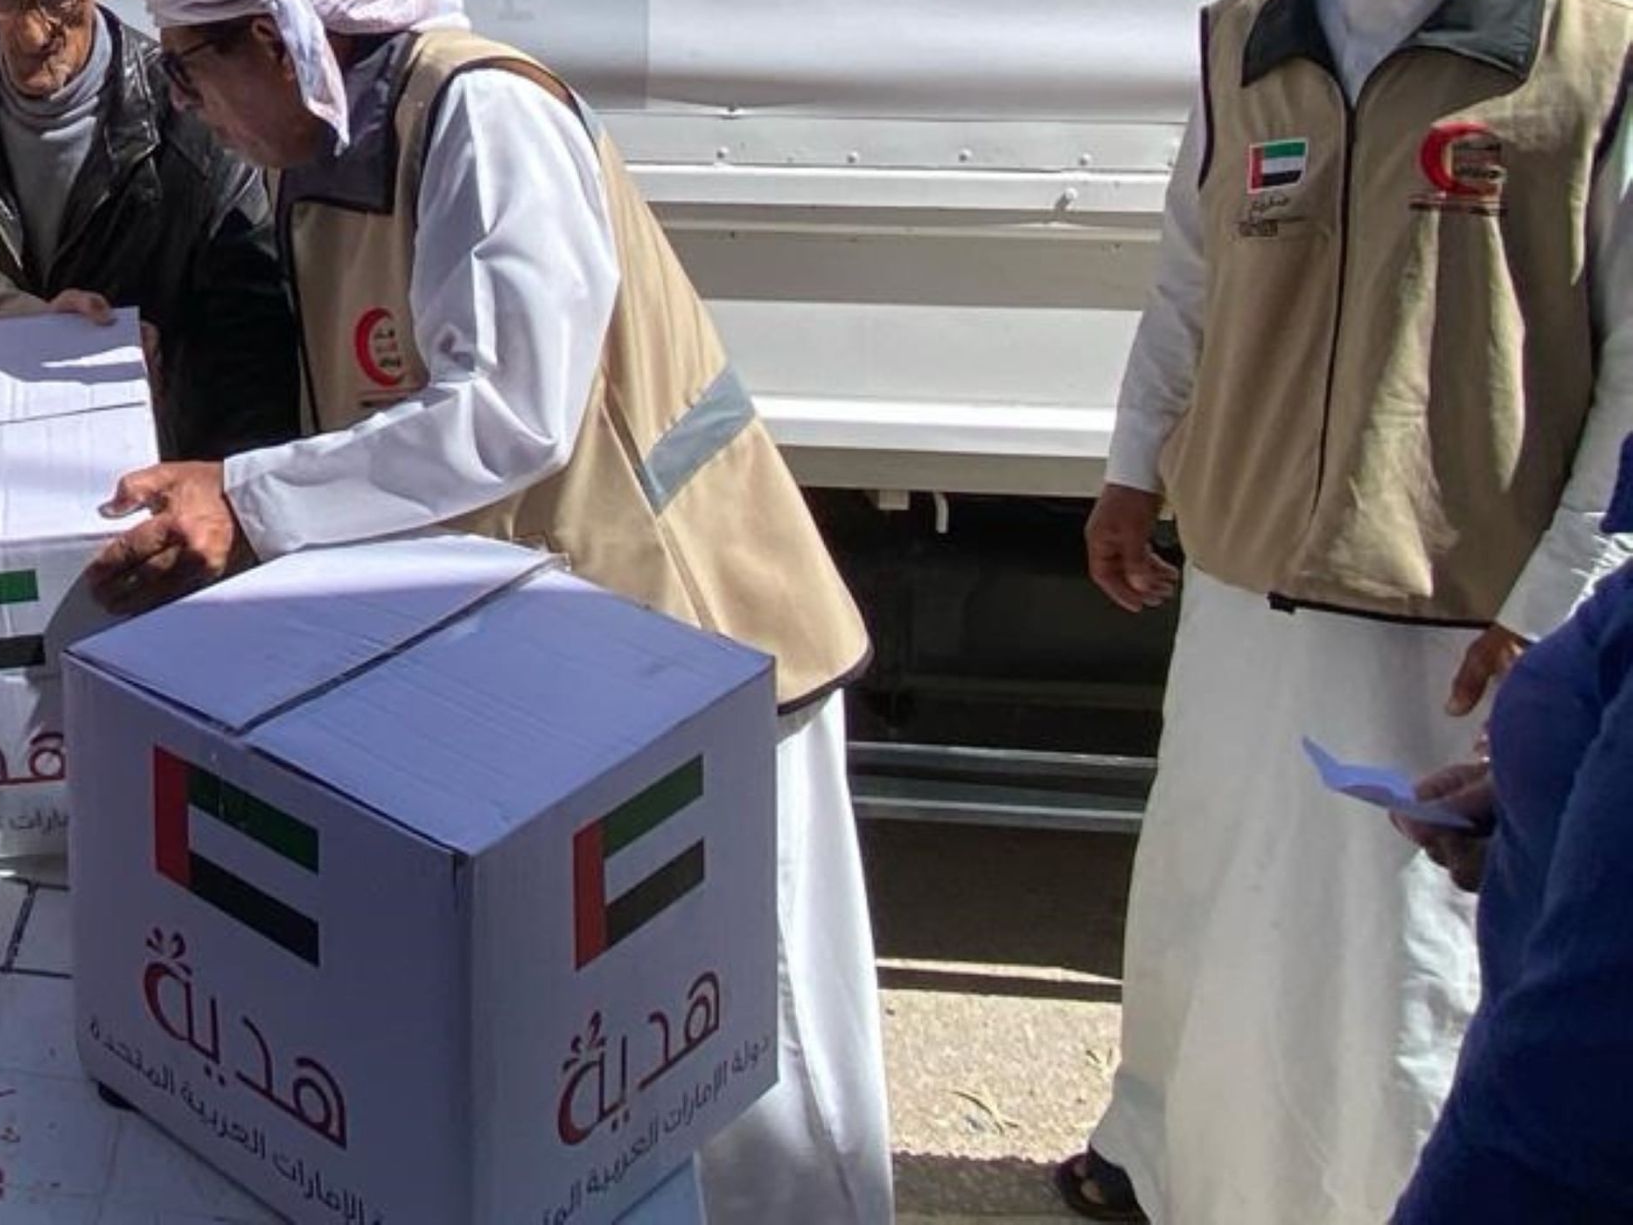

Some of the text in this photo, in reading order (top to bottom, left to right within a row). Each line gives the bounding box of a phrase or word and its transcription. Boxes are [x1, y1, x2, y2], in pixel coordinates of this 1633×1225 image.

[89, 1017, 175, 1097] المتحدة
[143, 926, 348, 1151] هدية
[557, 970, 719, 1146] هدية
[181, 1081, 266, 1161] العربية
